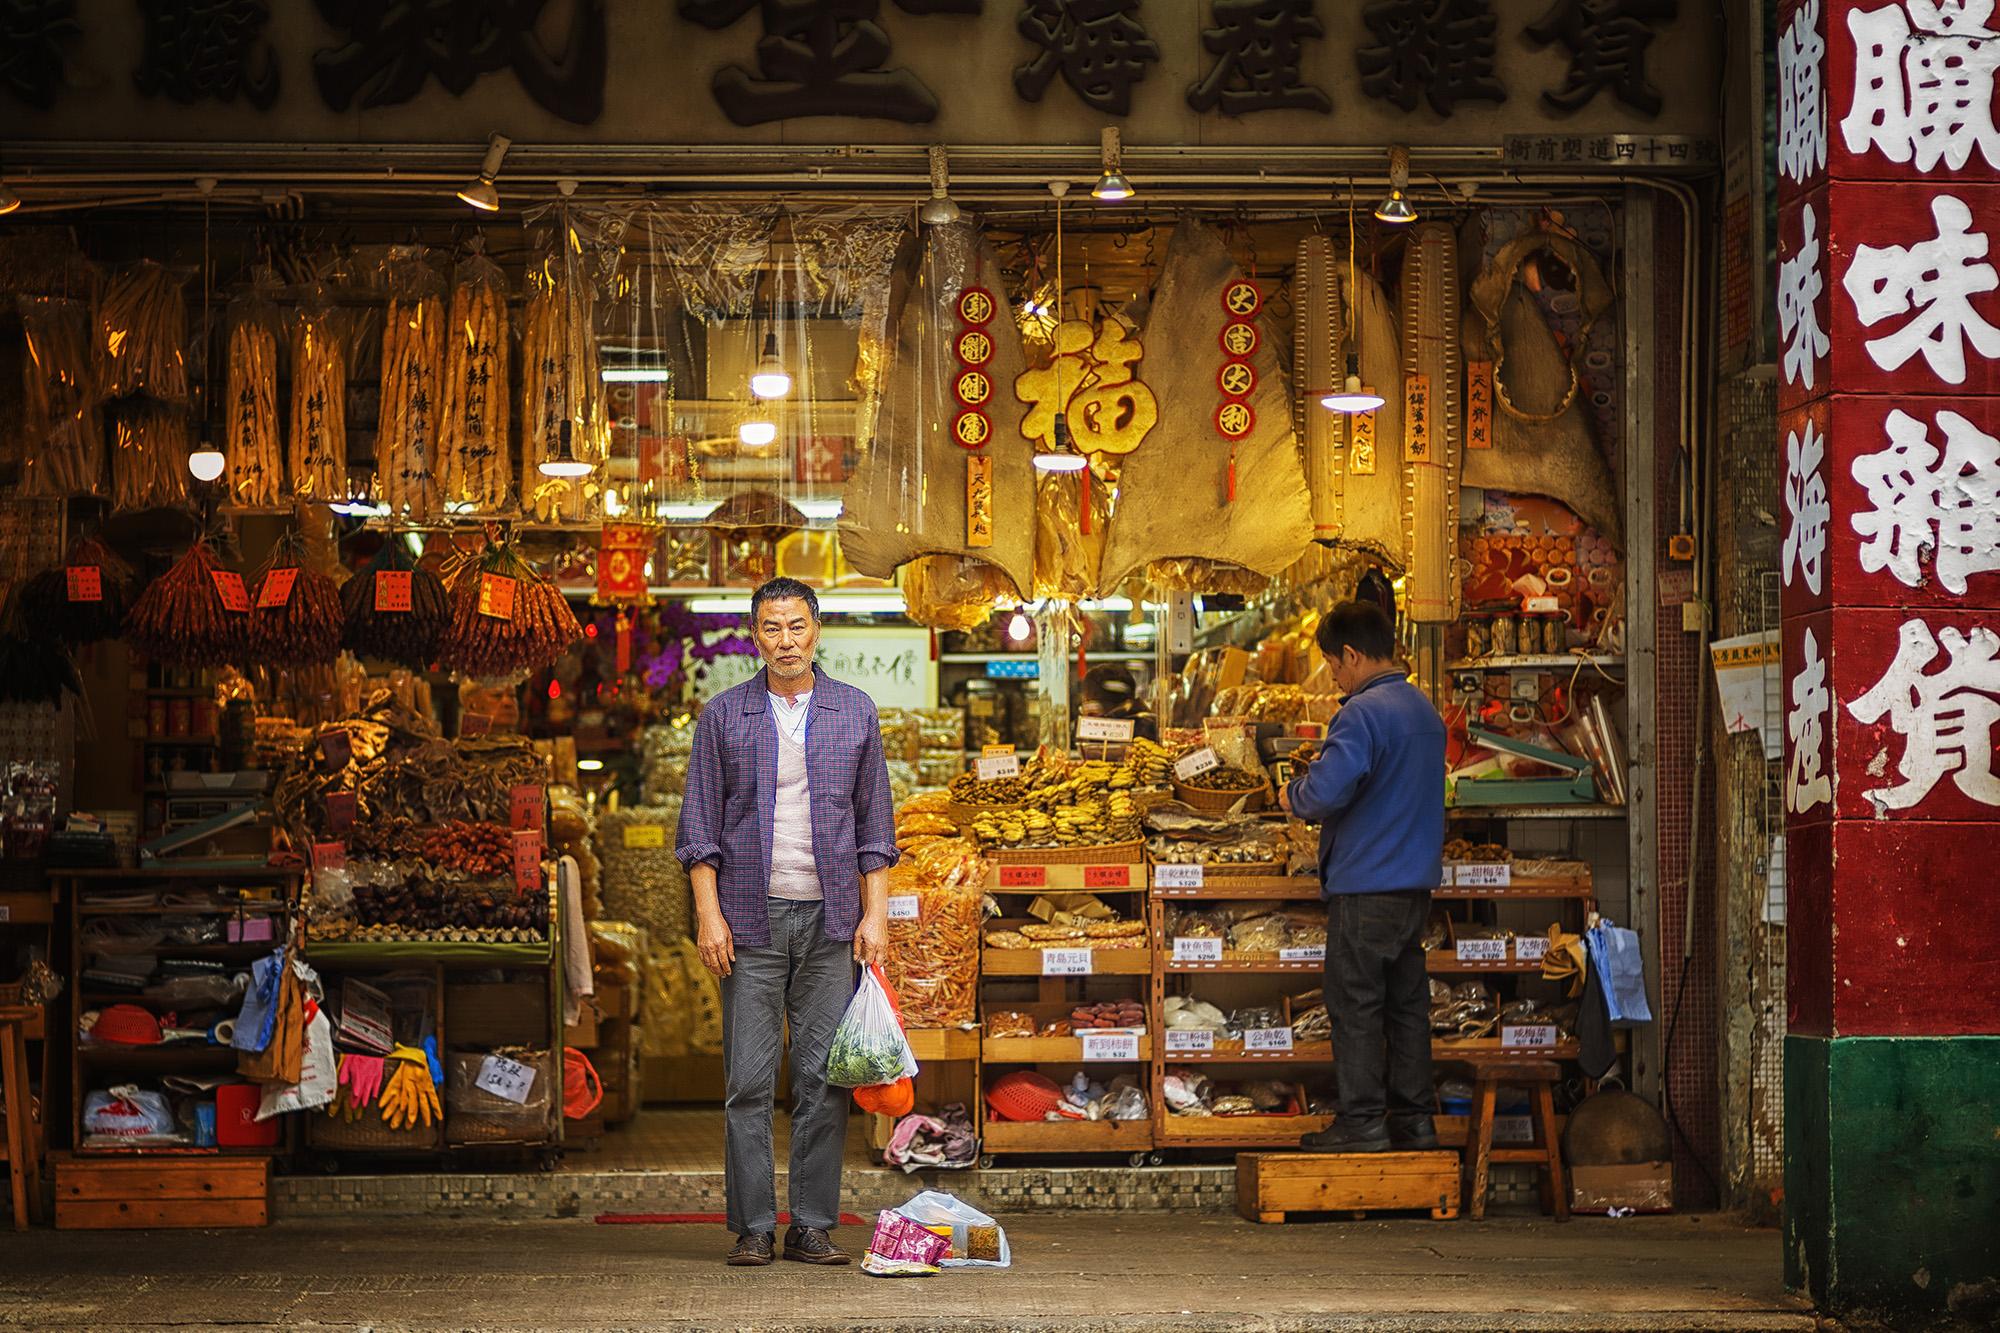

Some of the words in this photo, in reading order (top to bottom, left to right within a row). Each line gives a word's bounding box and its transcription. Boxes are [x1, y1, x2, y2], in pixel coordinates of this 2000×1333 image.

[1015, 317, 1159, 455] 福
[1222, 285, 1255, 434] 大吉大利
